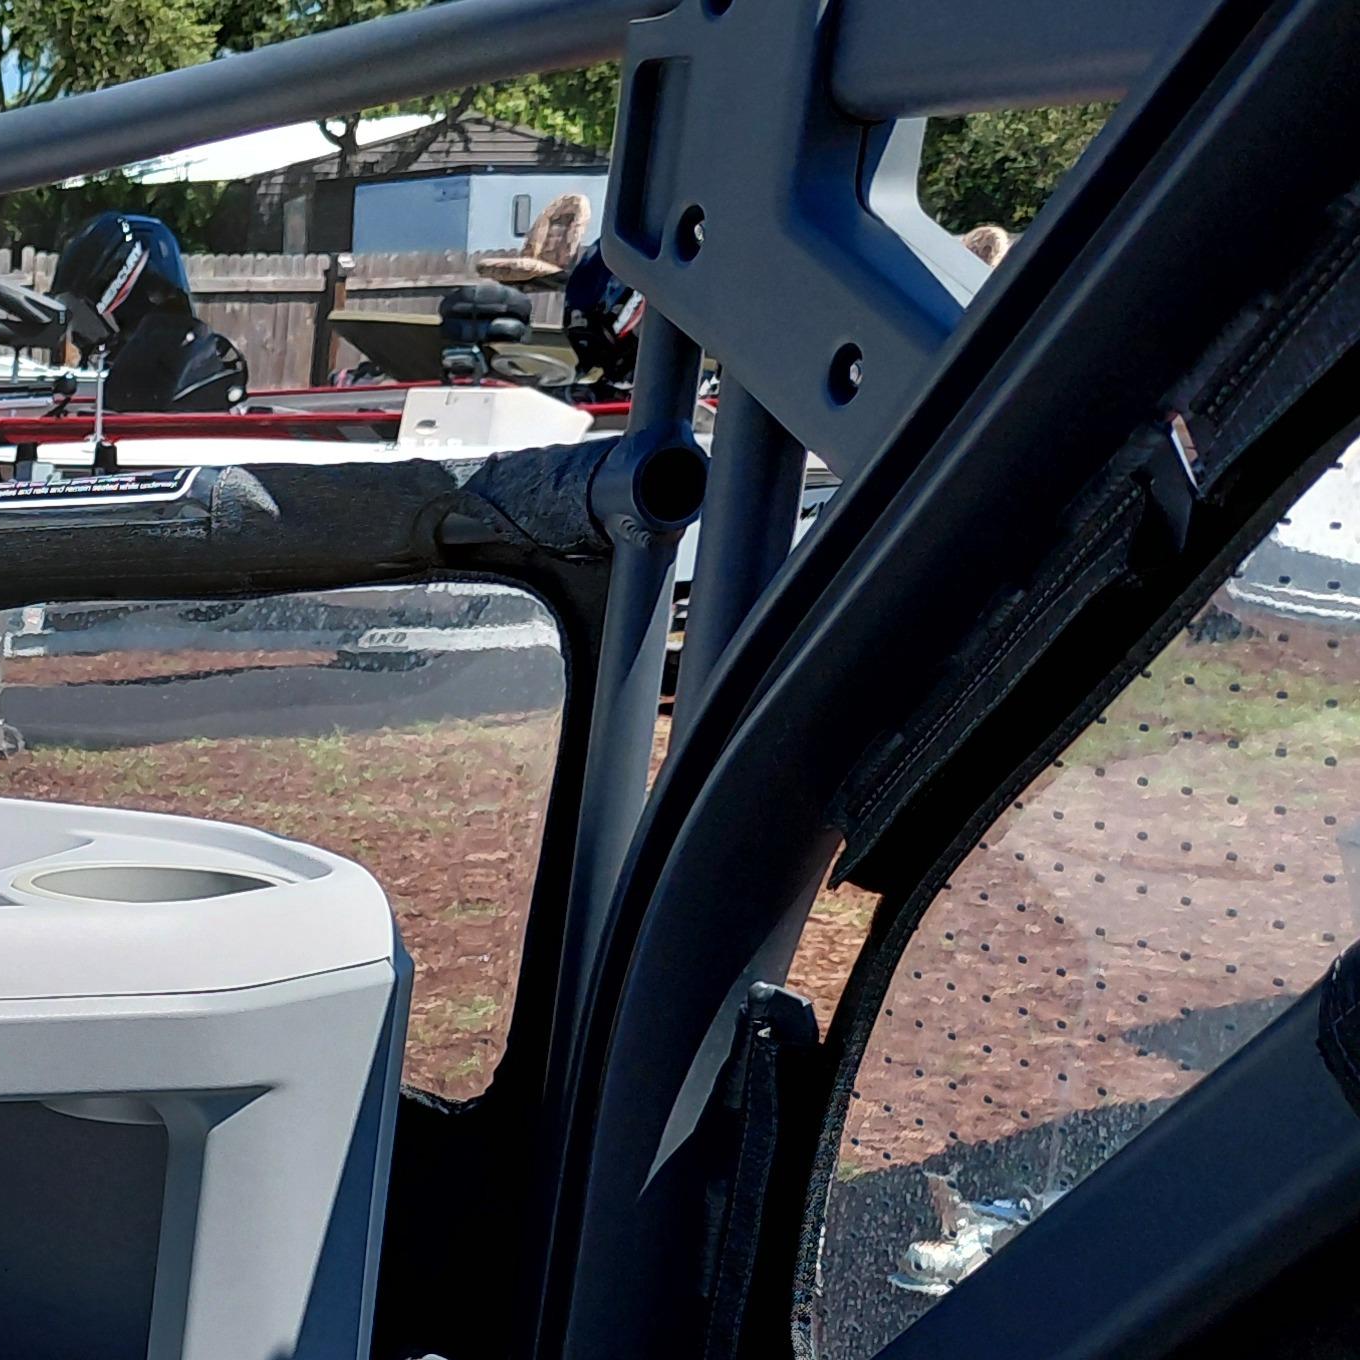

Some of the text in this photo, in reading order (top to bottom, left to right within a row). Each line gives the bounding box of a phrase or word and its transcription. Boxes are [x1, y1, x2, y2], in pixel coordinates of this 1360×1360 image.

[96, 240, 142, 315] MERCURY
[18, 487, 33, 496] and
[50, 485, 66, 494] and
